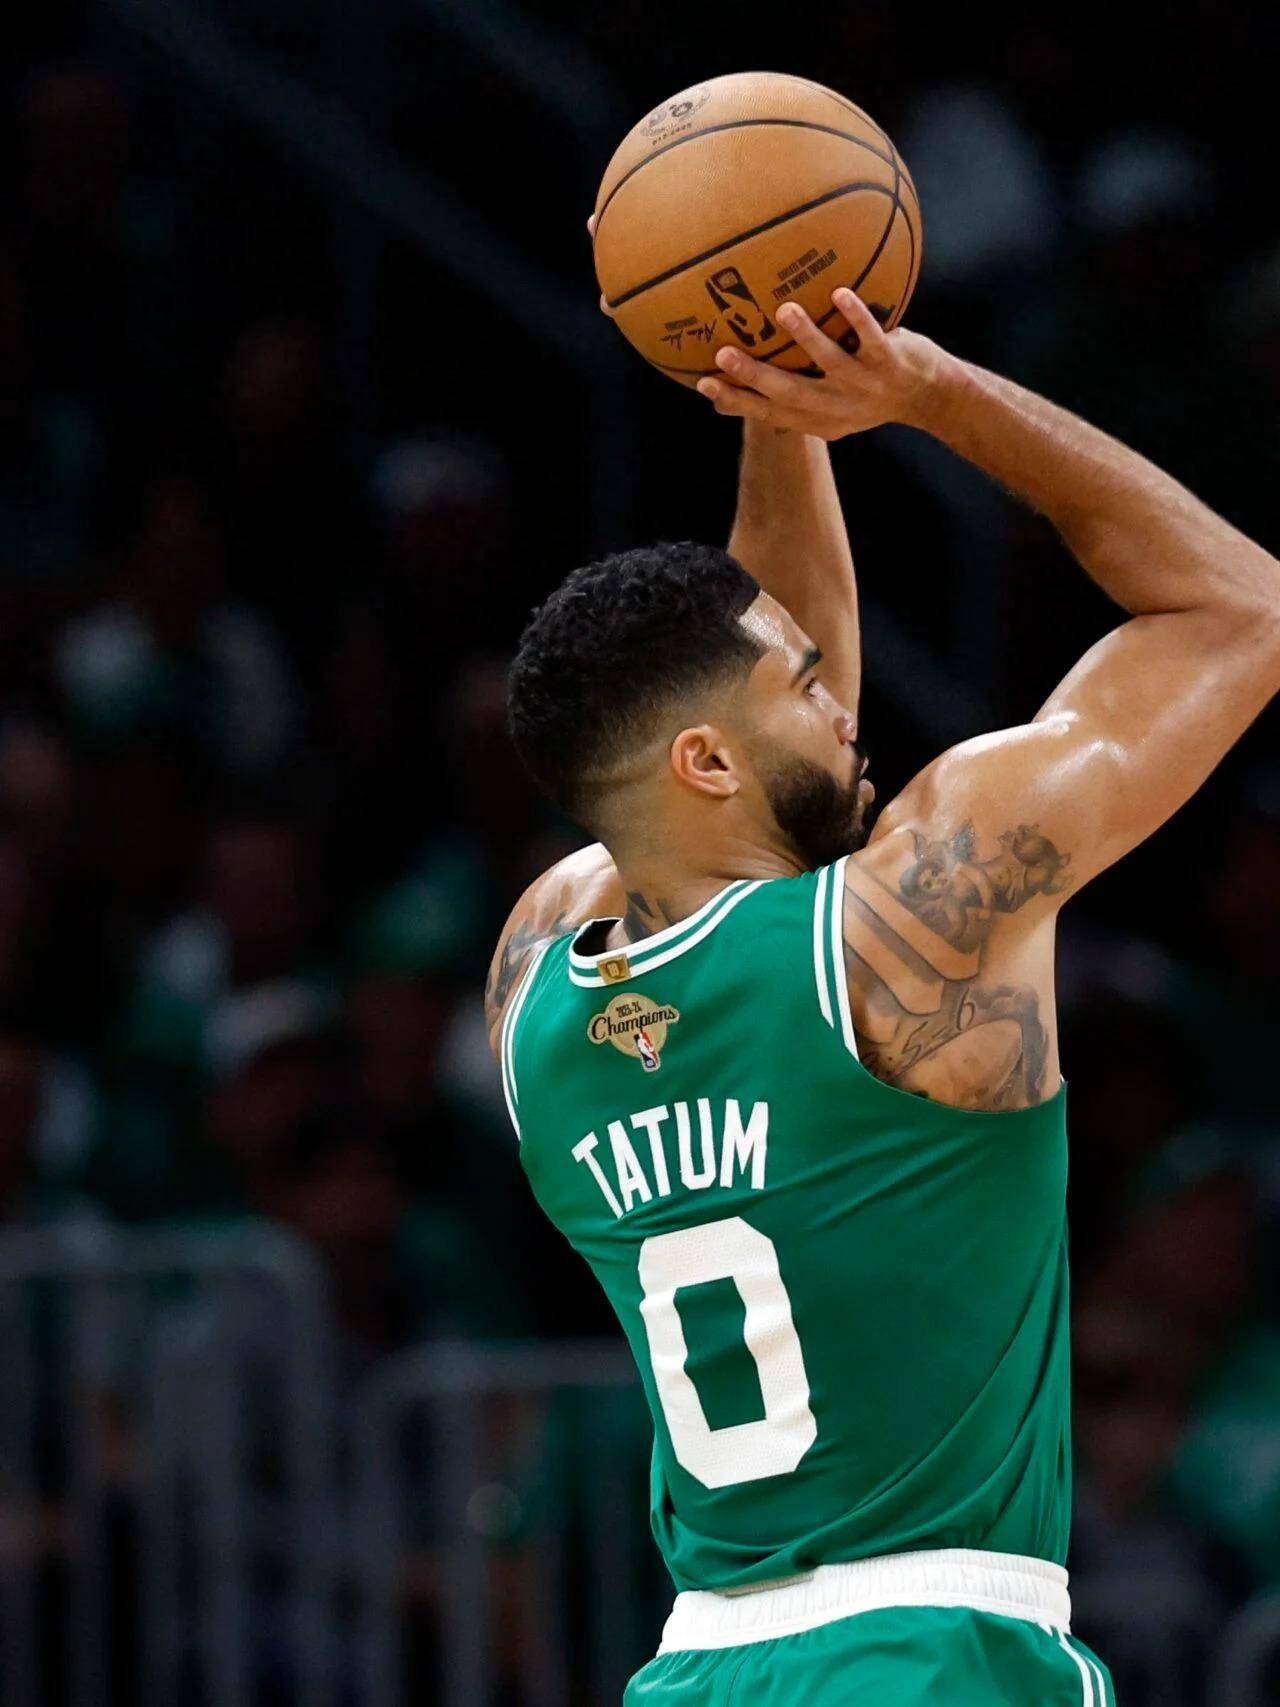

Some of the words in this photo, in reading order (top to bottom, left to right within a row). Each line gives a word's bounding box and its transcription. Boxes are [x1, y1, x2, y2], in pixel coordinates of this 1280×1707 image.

[591, 1008, 676, 1041] Champions
[571, 1098, 769, 1220] TATUM
[638, 1216, 818, 1490] 0
